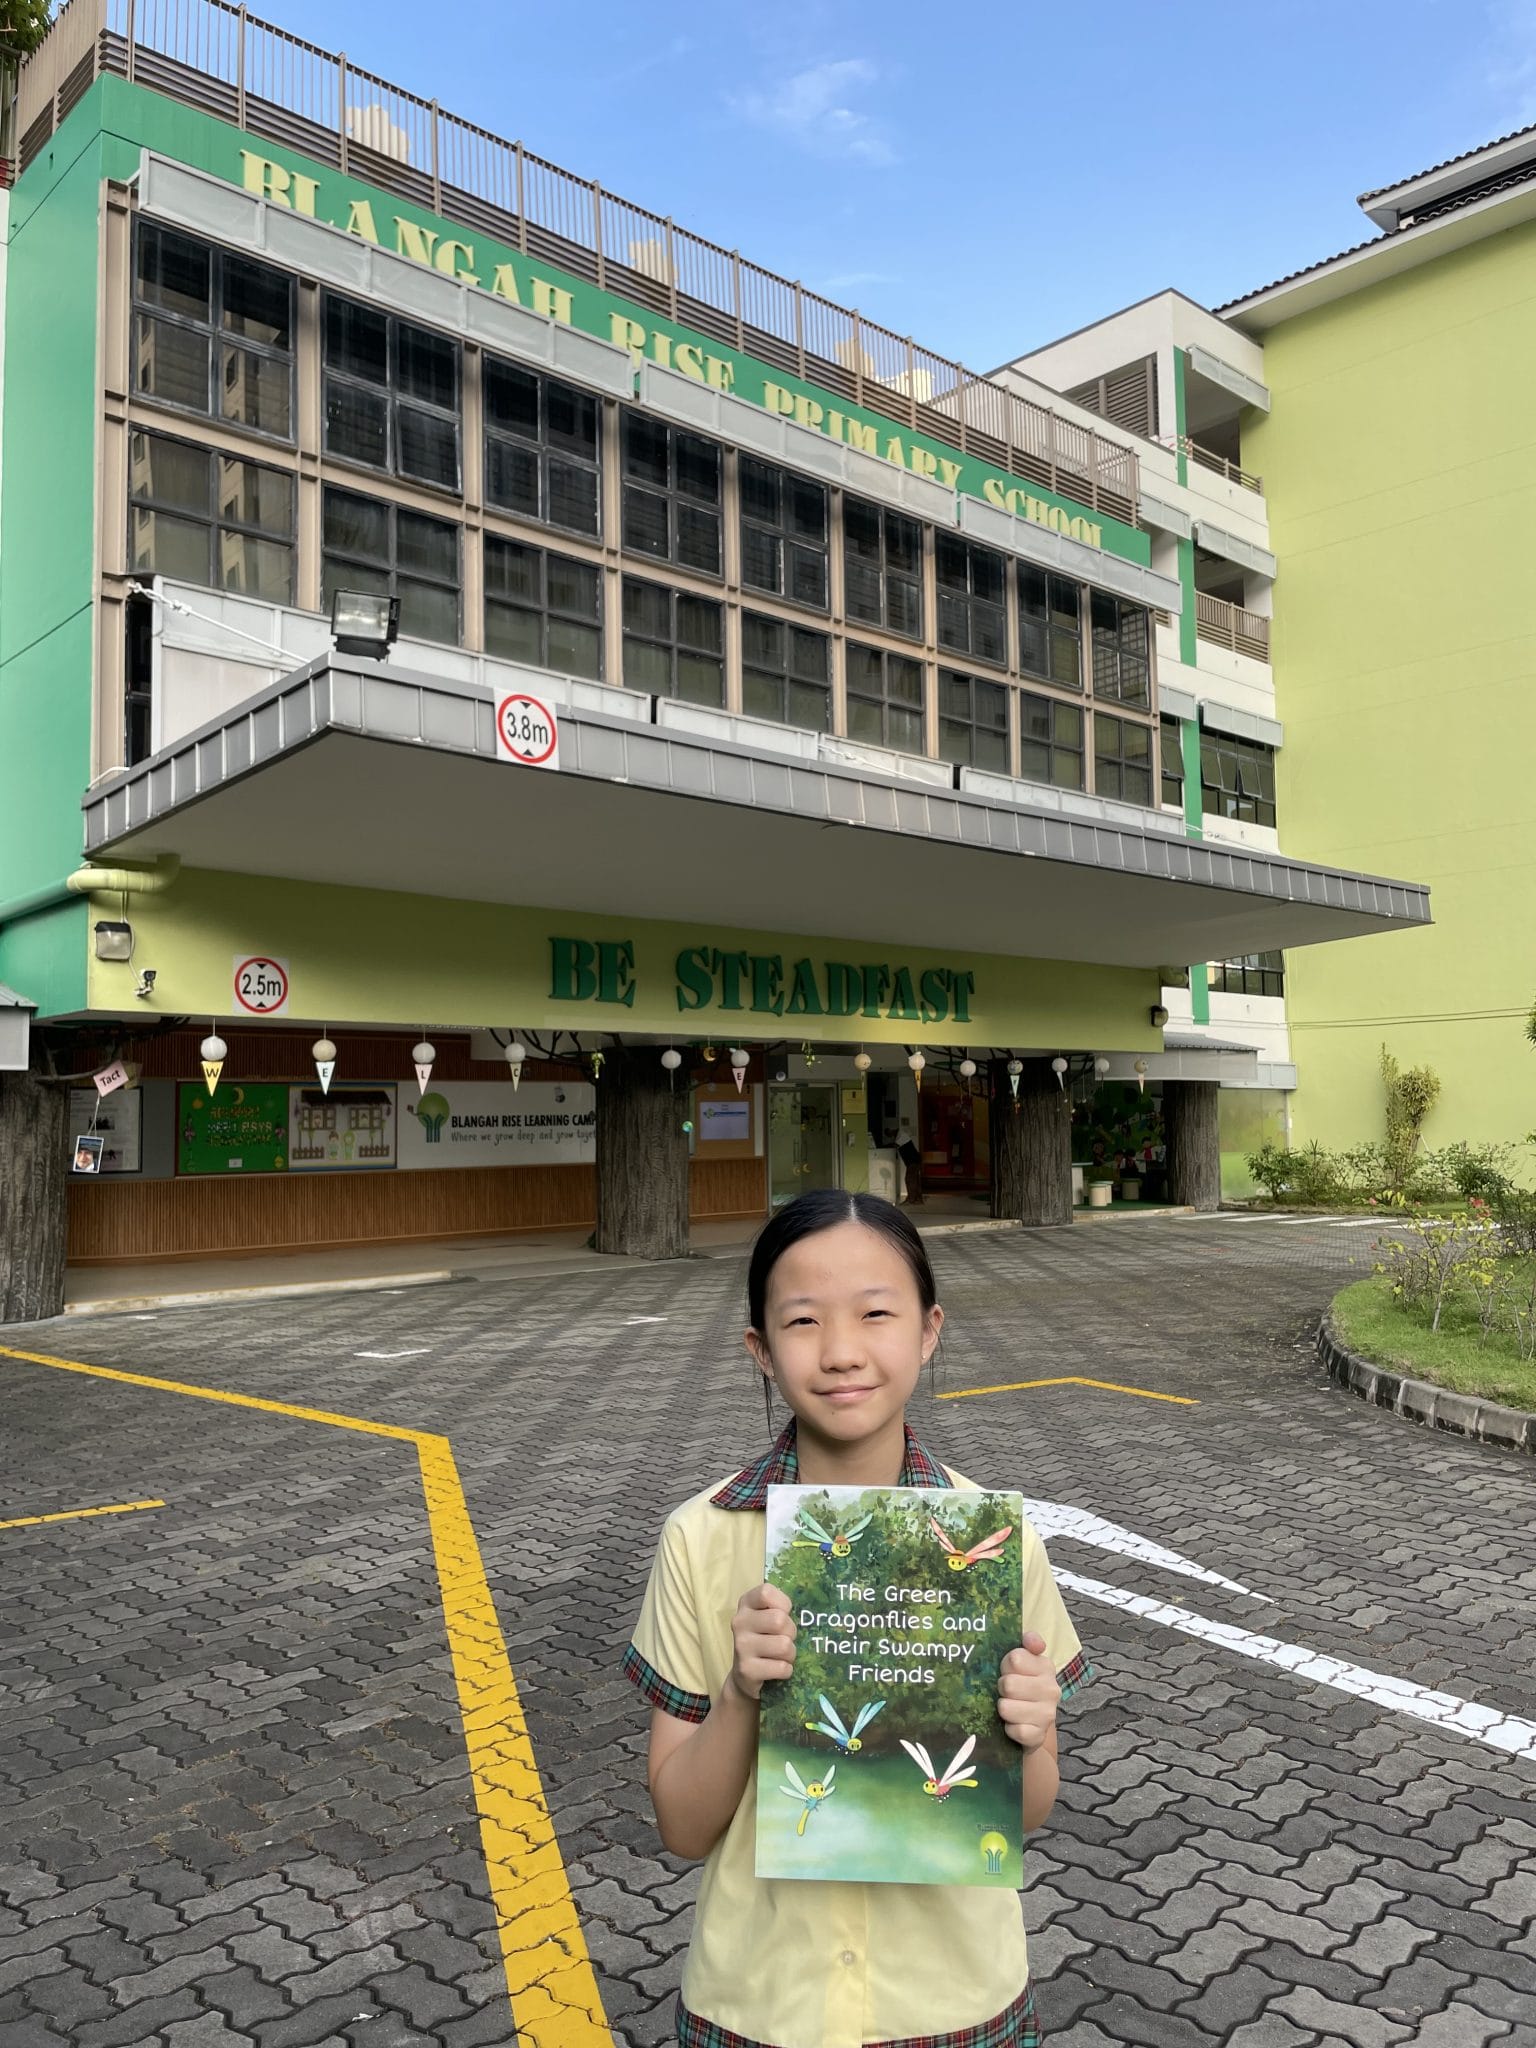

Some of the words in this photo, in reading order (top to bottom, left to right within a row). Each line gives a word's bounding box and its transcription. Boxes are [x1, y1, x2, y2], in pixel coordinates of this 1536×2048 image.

[240, 149, 574, 326] BLANGAH
[608, 312, 736, 397] RISE
[763, 381, 963, 490] PRIMARY
[507, 711, 548, 745] 3.8m
[242, 973, 281, 996] 2.5m
[547, 936, 637, 1008] BE
[675, 946, 976, 1024] STEADFAST
[100, 1070, 121, 1087] Tact
[206, 1067, 219, 1078] W
[322, 1067, 329, 1078] E
[736, 1072, 742, 1081] E
[451, 1115, 499, 1128] BLANGAH
[502, 1115, 522, 1127] RISE
[524, 1114, 570, 1127] LEARNING
[451, 1131, 478, 1142] Where
[480, 1133, 491, 1141] we
[494, 1133, 514, 1147] grow
[518, 1129, 536, 1145] deep
[539, 1129, 553, 1140] and
[836, 1583, 876, 1602] The
[884, 1585, 952, 1605] Green
[799, 1609, 933, 1634] Dragonflies
[942, 1614, 987, 1632] and
[811, 1635, 871, 1655] Their
[879, 1638, 976, 1664] Swampy
[848, 1664, 936, 1684] Friends
